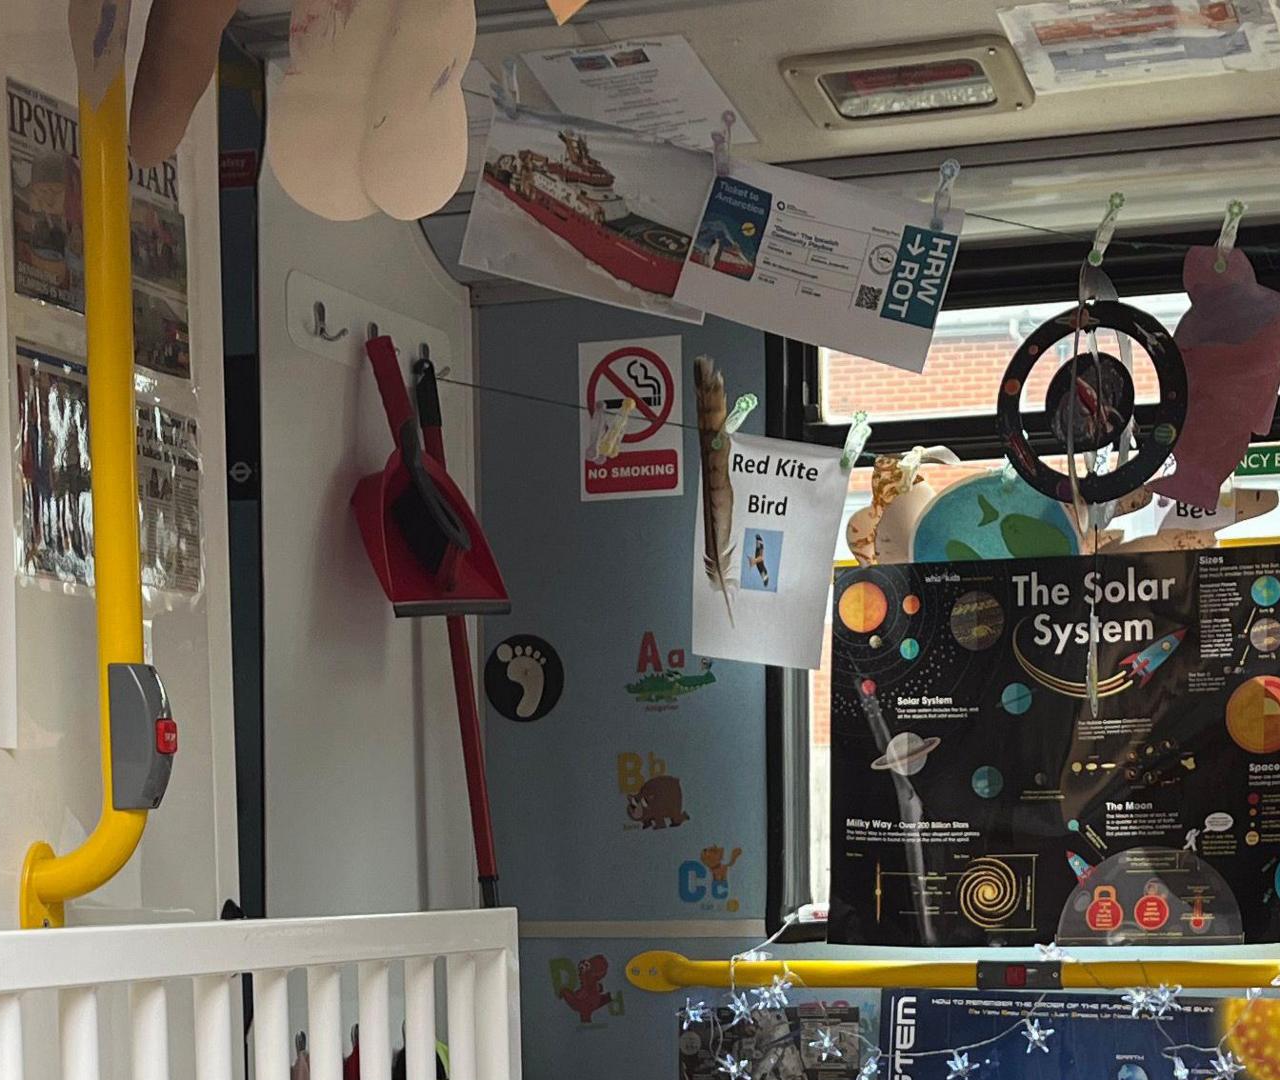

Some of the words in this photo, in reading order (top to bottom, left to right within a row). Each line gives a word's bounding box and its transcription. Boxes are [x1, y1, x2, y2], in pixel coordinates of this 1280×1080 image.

[8, 92, 81, 159] IPSWI
[720, 180, 748, 199] Ticket
[749, 191, 759, 202] to
[916, 236, 952, 307] HRW
[887, 260, 920, 320] ROT
[588, 467, 608, 480] NO
[611, 463, 675, 478] SMOKING
[732, 453, 771, 476] Red
[775, 457, 819, 482] Kite
[747, 494, 789, 517] Bird
[1199, 556, 1224, 565] Sizes
[1011, 571, 1071, 607] The
[1083, 566, 1176, 606] Solar
[1033, 613, 1154, 655] System
[897, 696, 919, 706] Solar
[921, 696, 953, 706] System
[1249, 763, 1280, 773] Space
[1105, 801, 1123, 811] The
[1125, 801, 1153, 810] Moon
[846, 818, 870, 829] Milky
[872, 818, 893, 829] Way
[898, 821, 917, 829] Over
[931, 821, 951, 829] Billion
[952, 821, 969, 829] Stars
